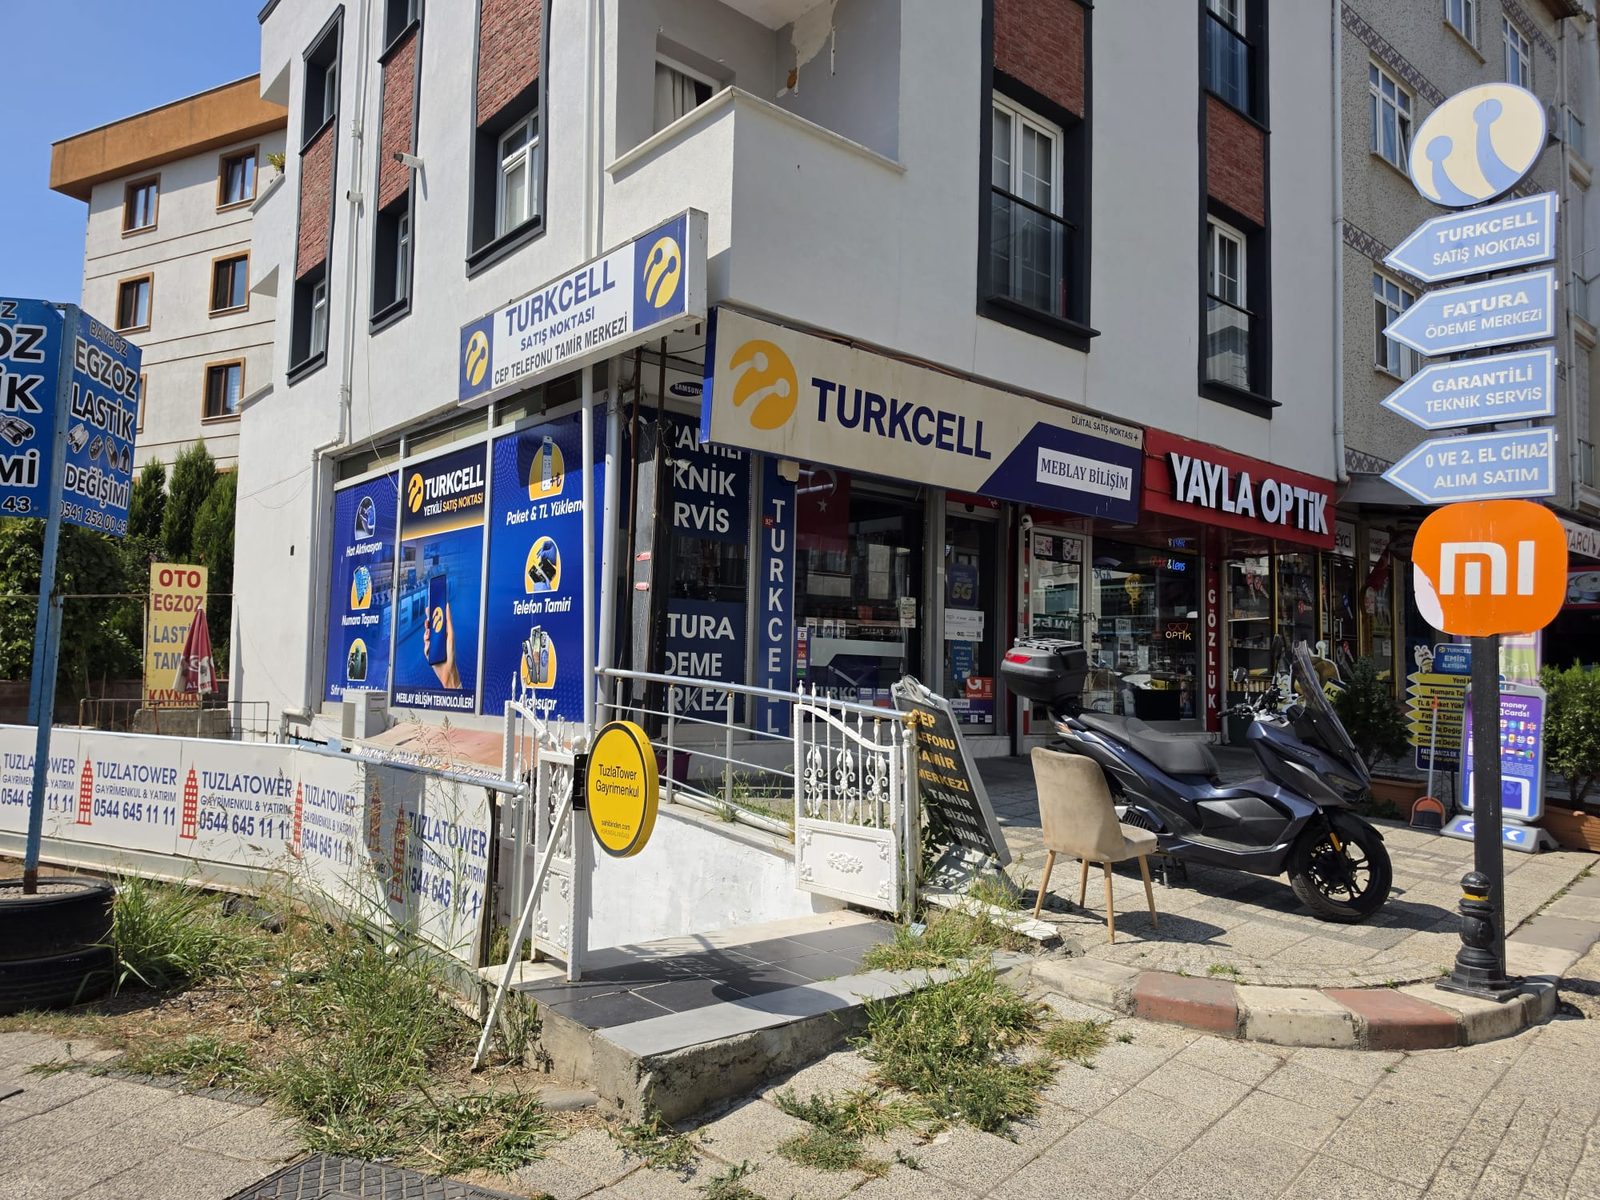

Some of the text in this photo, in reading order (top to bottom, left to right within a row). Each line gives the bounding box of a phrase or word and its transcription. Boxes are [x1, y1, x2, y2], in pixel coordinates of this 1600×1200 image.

[1437, 212, 1538, 244] TURKCELL
[1433, 232, 1540, 266] SATIŞ NOKTASI
[505, 259, 616, 336] TURKCELL
[1442, 291, 1529, 318] FATURA
[520, 306, 595, 352] SATIŞ NOKTASI
[1425, 309, 1542, 339] ÖDEME MERKEZİ
[494, 311, 628, 385] CEP TELEFONU TAMİR MERKEZİ
[74, 336, 138, 400] EGZOZ
[1431, 364, 1533, 393] GARANTİLİ
[1425, 386, 1542, 413] TEKNİK SERVİS
[71, 383, 135, 444] LASTİK
[811, 377, 992, 460] TURKCELL
[1437, 451, 1457, 466] VE
[1461, 450, 1474, 465] 2.
[1478, 447, 1496, 463] EL
[1501, 442, 1548, 461] CİHAZ
[64, 461, 130, 509] DEĞİŞİMİ
[425, 464, 484, 500] TURKCELL
[1040, 457, 1129, 491] MEBLAY BİLİŞİM
[1433, 467, 1539, 489] ALIM SATIM
[423, 492, 484, 517] YETKİLİ SATIŞ NOKTASI
[1169, 452, 1329, 535] YAYLA OPTİK
[85, 507, 104, 527] 252
[104, 514, 116, 532] 00
[116, 518, 128, 536] 43
[506, 509, 529, 526] Paket
[530, 506, 537, 521] &
[538, 504, 548, 519] TL
[346, 541, 383, 557] Hat Aktivasyon
[158, 569, 202, 589] OTO
[153, 593, 204, 613] EGZOZ
[513, 597, 572, 615] Telefon Tamiri
[153, 623, 191, 644] LAST
[341, 613, 379, 628] Numara Taşıma
[667, 613, 735, 640] TURA
[1165, 631, 1191, 641] OPTİK
[1207, 589, 1216, 709] GÖZLÜK
[154, 652, 182, 670] TAM
[396, 692, 474, 709] MEBLAY BİLİŞİM TEKNOLOJİLERİ
[664, 682, 733, 711] RKEZ
[4, 753, 76, 775] TUZLAWER
[96, 761, 178, 786] TUZLATOWER
[598, 764, 637, 781] TuzlaTower
[919, 750, 958, 771] AMİR
[2, 773, 75, 790] GAYRİMEN YATIRIM
[95, 783, 177, 802] GAYRİMENKUL & YATIRIM
[202, 771, 293, 798] TUZLATOWER
[595, 779, 640, 798] Gayrimenkul
[1, 788, 24, 808] 0544
[200, 795, 253, 811] GAYRİMENKUL
[254, 801, 260, 811] &
[304, 784, 356, 818] TUZLATOWER
[928, 788, 973, 811] TAMİR
[93, 798, 176, 826] 0544 645 11 11
[199, 811, 228, 833] 0544
[232, 814, 255, 836] 645
[258, 818, 273, 839] 11
[302, 828, 318, 854] 0544
[319, 834, 332, 859] 645
[334, 839, 342, 862] 11
[460, 862, 486, 884] ATIRIM
[432, 875, 452, 908] 645
